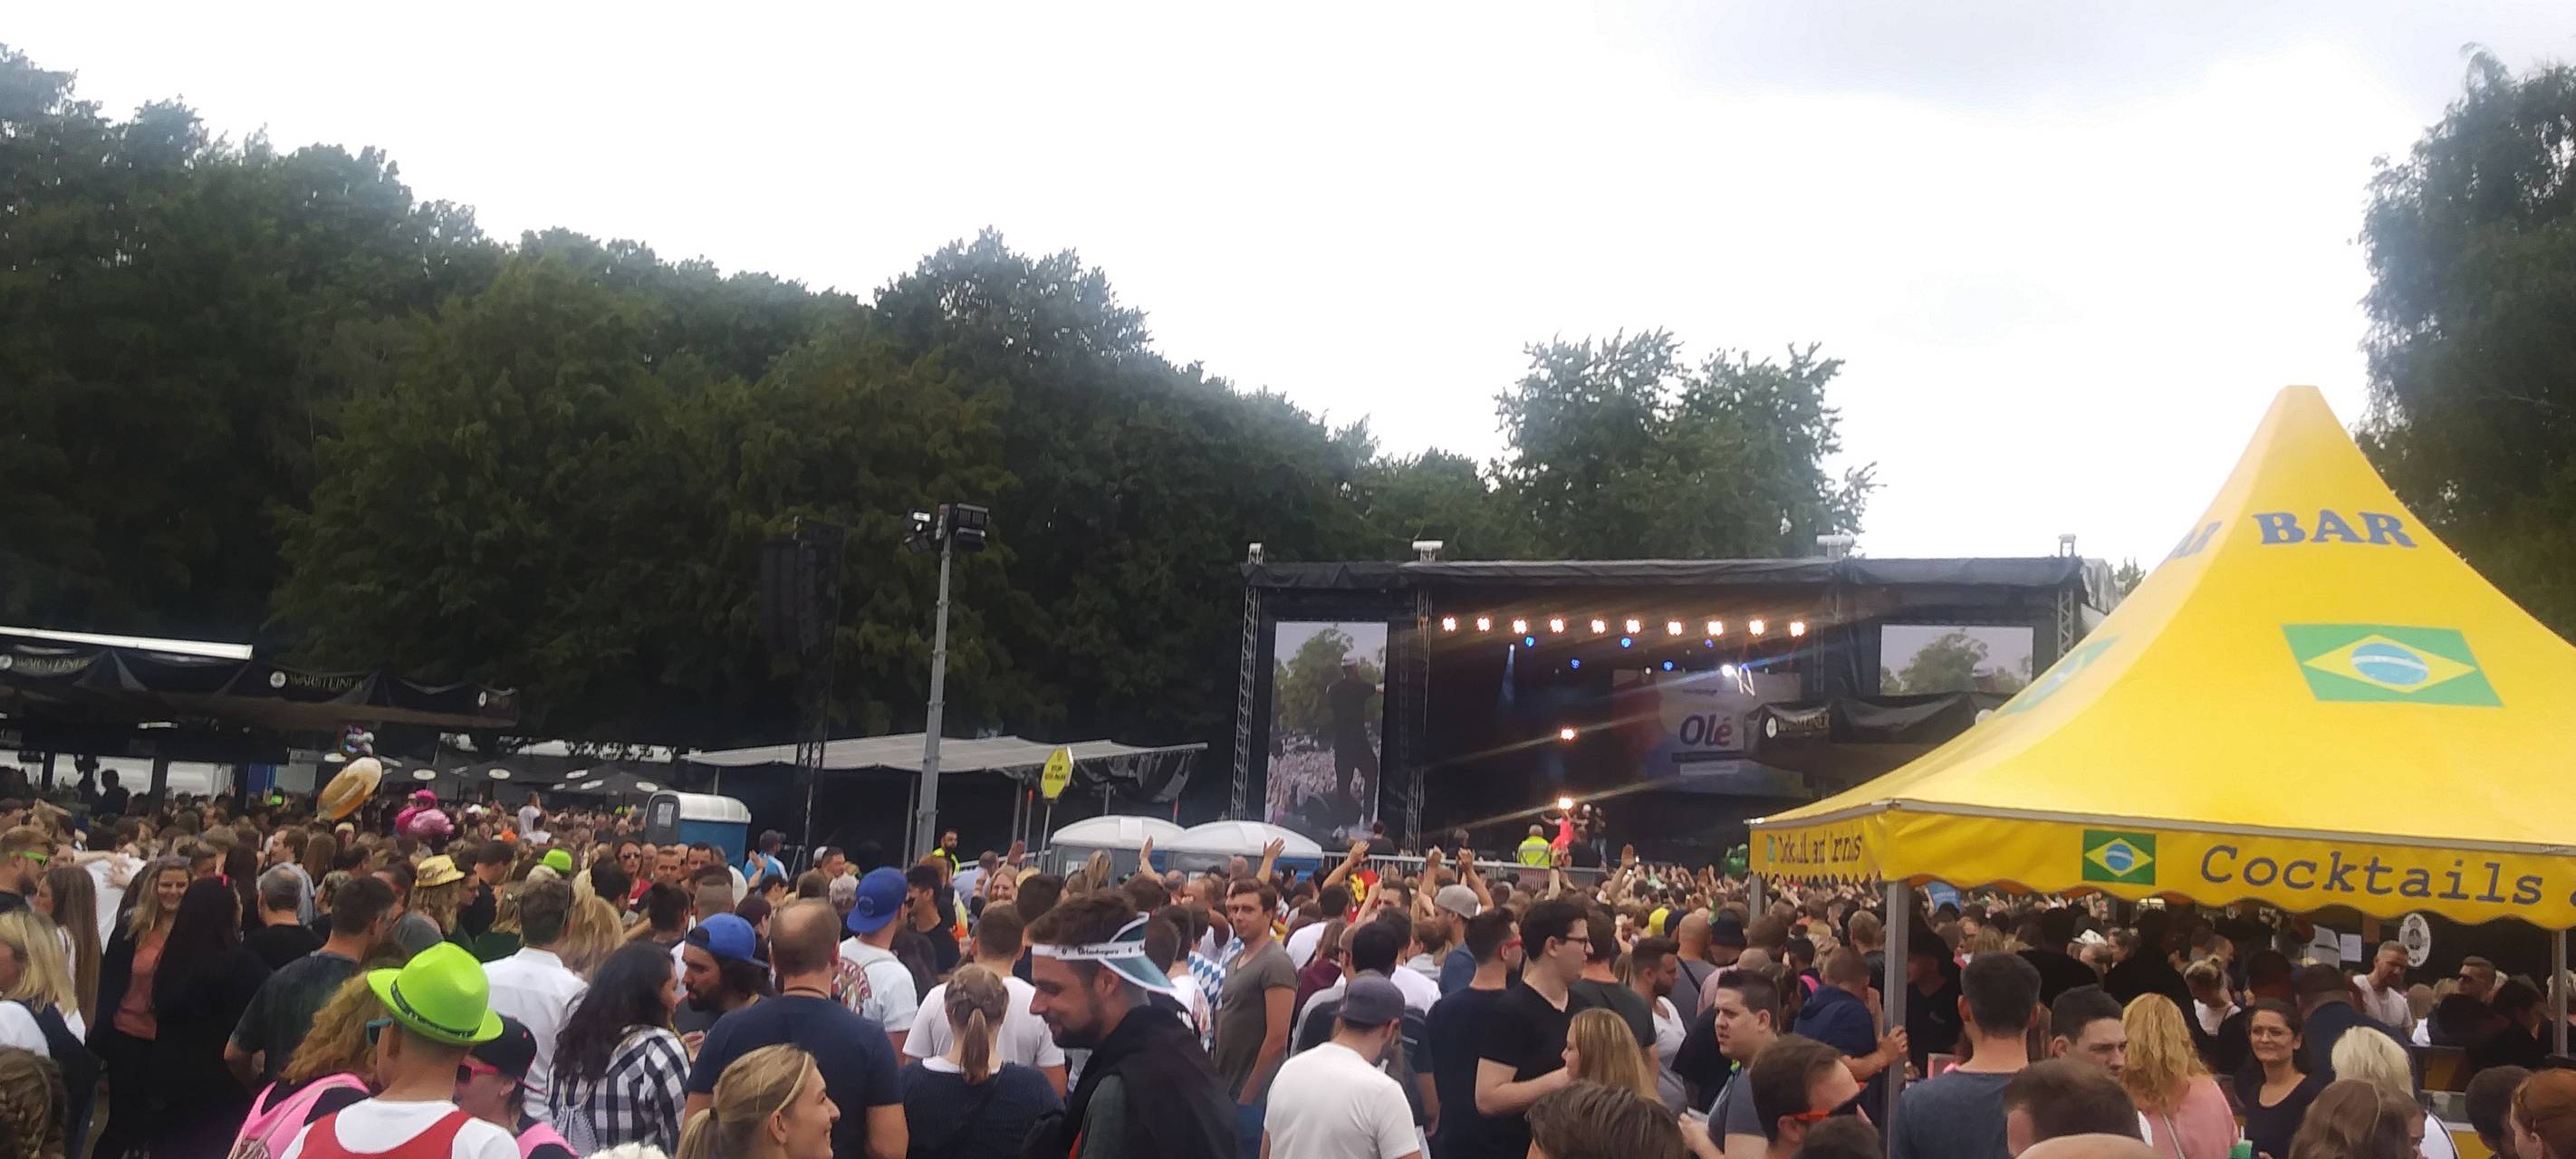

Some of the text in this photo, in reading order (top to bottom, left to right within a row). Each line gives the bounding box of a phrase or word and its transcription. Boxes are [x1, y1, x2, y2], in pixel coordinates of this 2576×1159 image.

[2252, 508, 2417, 548] BAR
[1679, 714, 1733, 747] Olé
[2201, 845, 2542, 905] Cocktails
